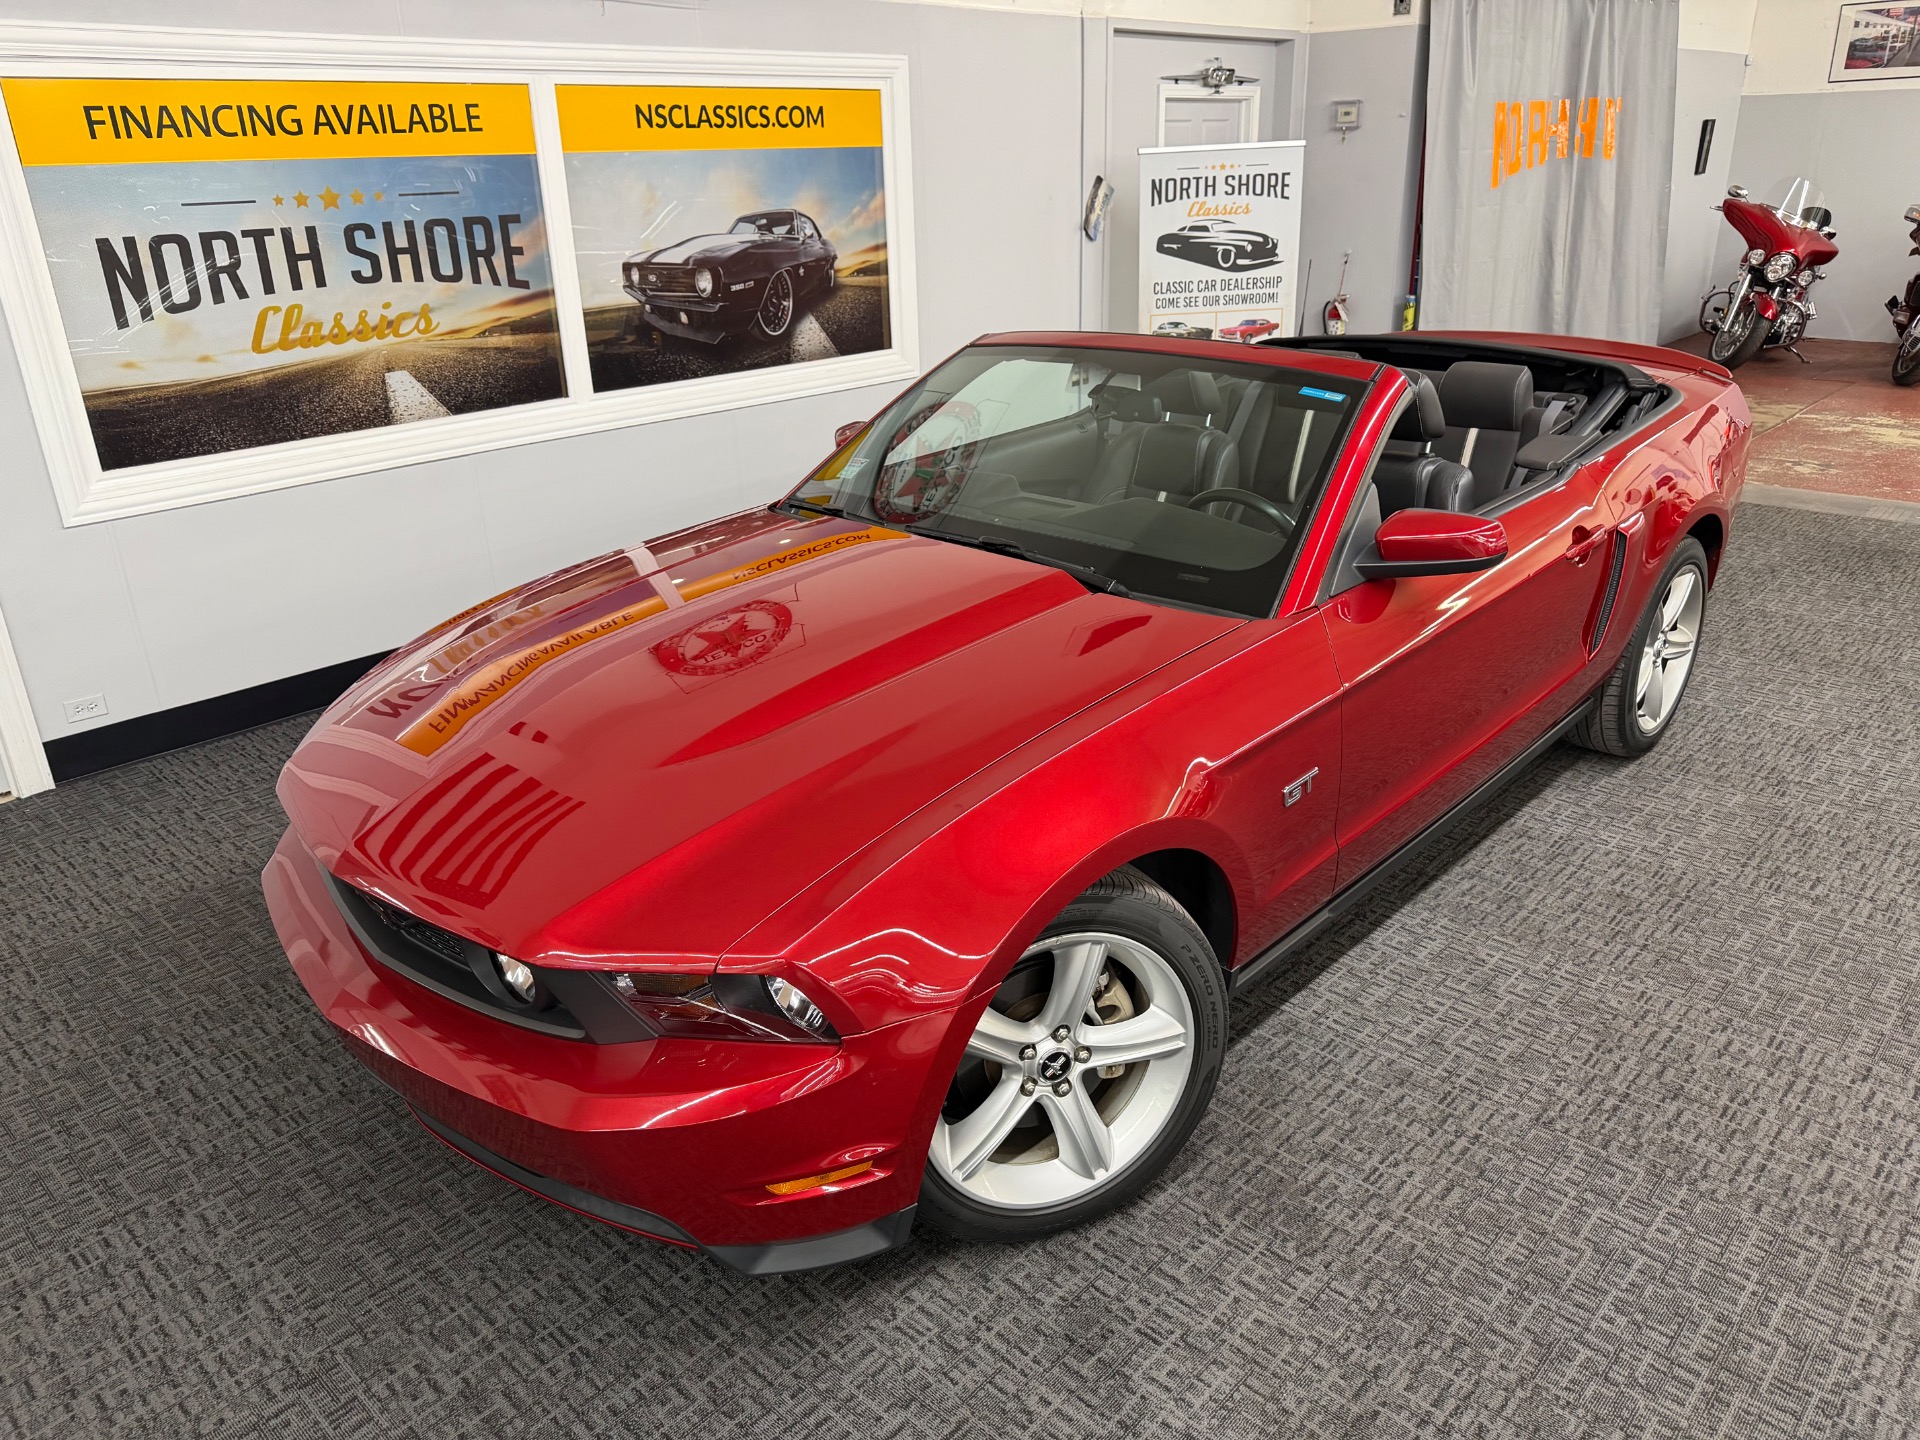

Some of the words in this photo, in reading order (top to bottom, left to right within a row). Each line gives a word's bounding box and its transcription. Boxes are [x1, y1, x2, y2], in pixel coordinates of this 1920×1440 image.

[83, 104, 302, 139] FINANCING
[313, 103, 483, 136] AVAILABLE
[635, 104, 825, 129] NSCLASSICS.COM
[1151, 175, 1216, 207] NORTH
[1224, 172, 1291, 200] SHORE
[1187, 201, 1252, 218] Classics
[95, 225, 328, 330] NORTH
[343, 213, 532, 290] SHORE
[1153, 280, 1194, 295] CLASSIC
[1197, 279, 1217, 293] CAR
[1220, 276, 1283, 292] DEALERSHIP
[1155, 296, 1181, 309] COME
[1183, 295, 1199, 308] SEE
[1202, 295, 1220, 307] OUR
[1223, 292, 1279, 306] SHOWROOM!
[251, 301, 440, 355] Classics
[1282, 767, 1319, 807] GT
[1189, 954, 1214, 996] ZERO
[1209, 1001, 1219, 1049] NERO
